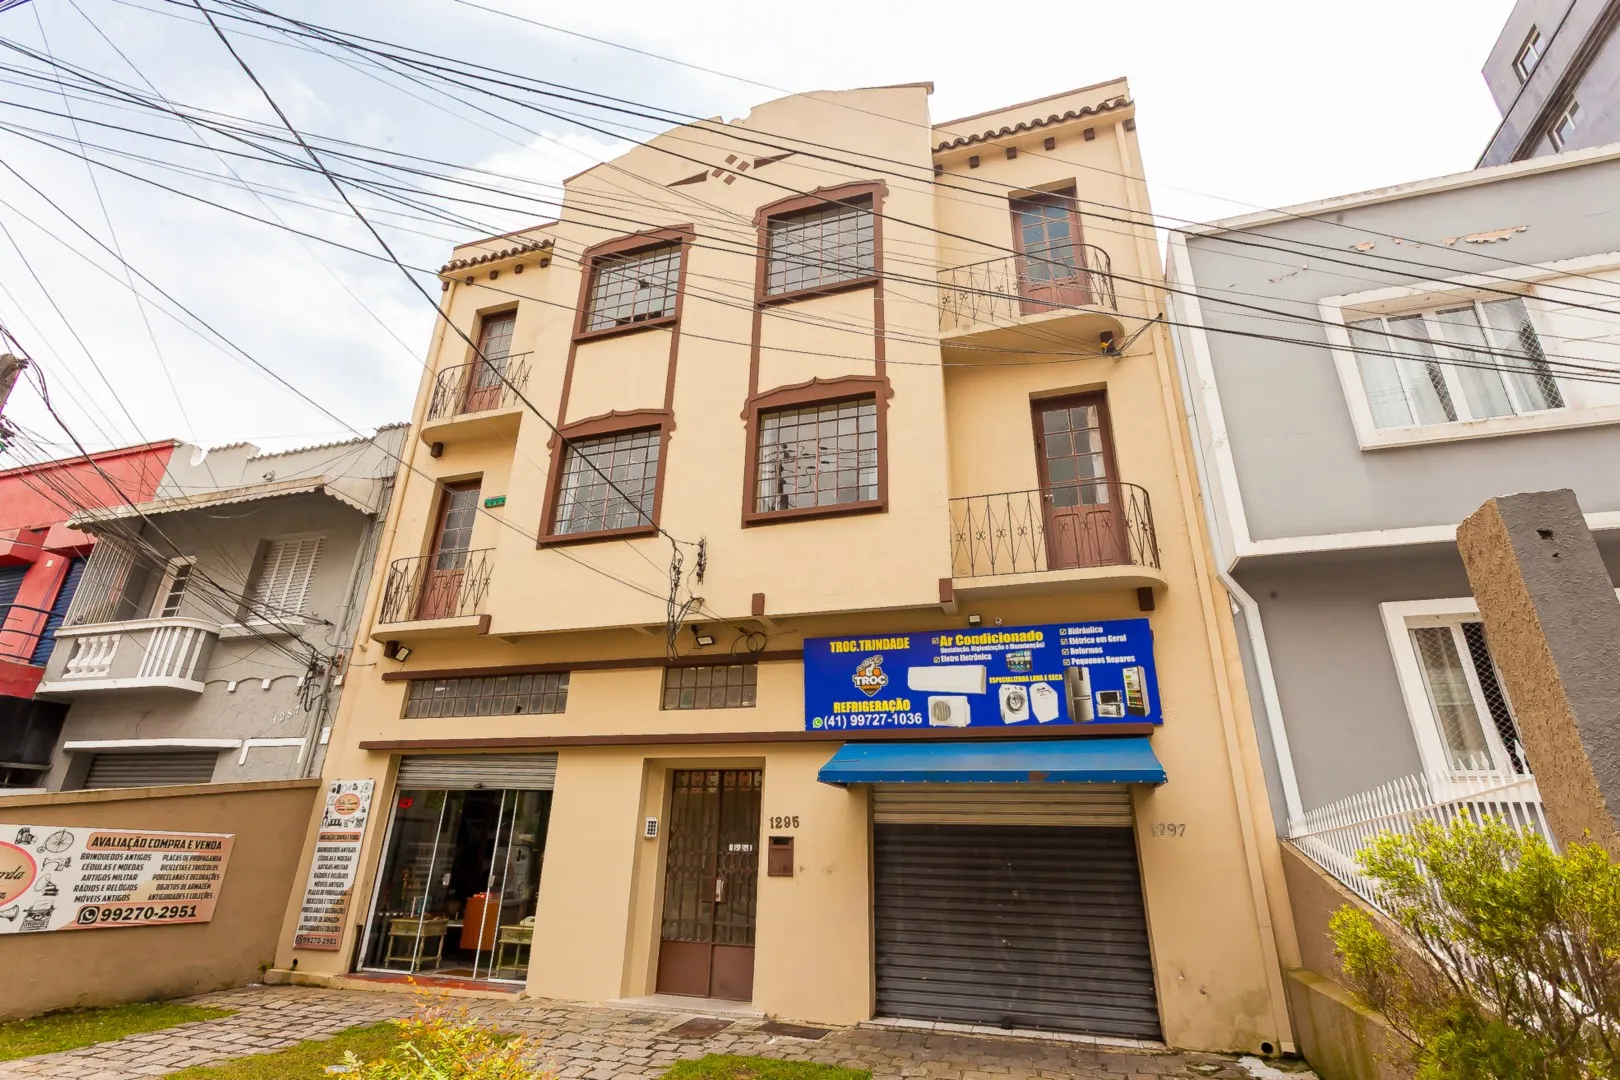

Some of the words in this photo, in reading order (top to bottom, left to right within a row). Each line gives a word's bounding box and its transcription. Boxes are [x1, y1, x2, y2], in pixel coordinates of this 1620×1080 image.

[940, 635, 953, 646] Ar
[956, 630, 1044, 646] Condicionado
[1108, 634, 1127, 643] Geral
[830, 637, 910, 653] TROC.TRINDADE
[1070, 647, 1104, 655] Reformas
[1071, 656, 1105, 665] Pequenos
[1106, 655, 1136, 664] Reparos
[854, 675, 886, 686] TROC
[833, 698, 910, 713] REFRIGERAÇÃO
[824, 714, 847, 729] (41)
[850, 712, 922, 726] 99727-1036
[770, 816, 800, 829] 1295
[1150, 822, 1186, 838] 1297
[91, 836, 147, 850] AVALIAÇÃO
[148, 838, 186, 849] COMPRA
[187, 840, 193, 849] E
[195, 841, 222, 850] VENDA
[81, 862, 112, 870] CÉDULAS
[73, 883, 100, 892] RÁDIOS
[106, 883, 138, 891] RELÓGIOS
[74, 894, 101, 903] MÓVEIS
[100, 905, 197, 922] 99270-2951
